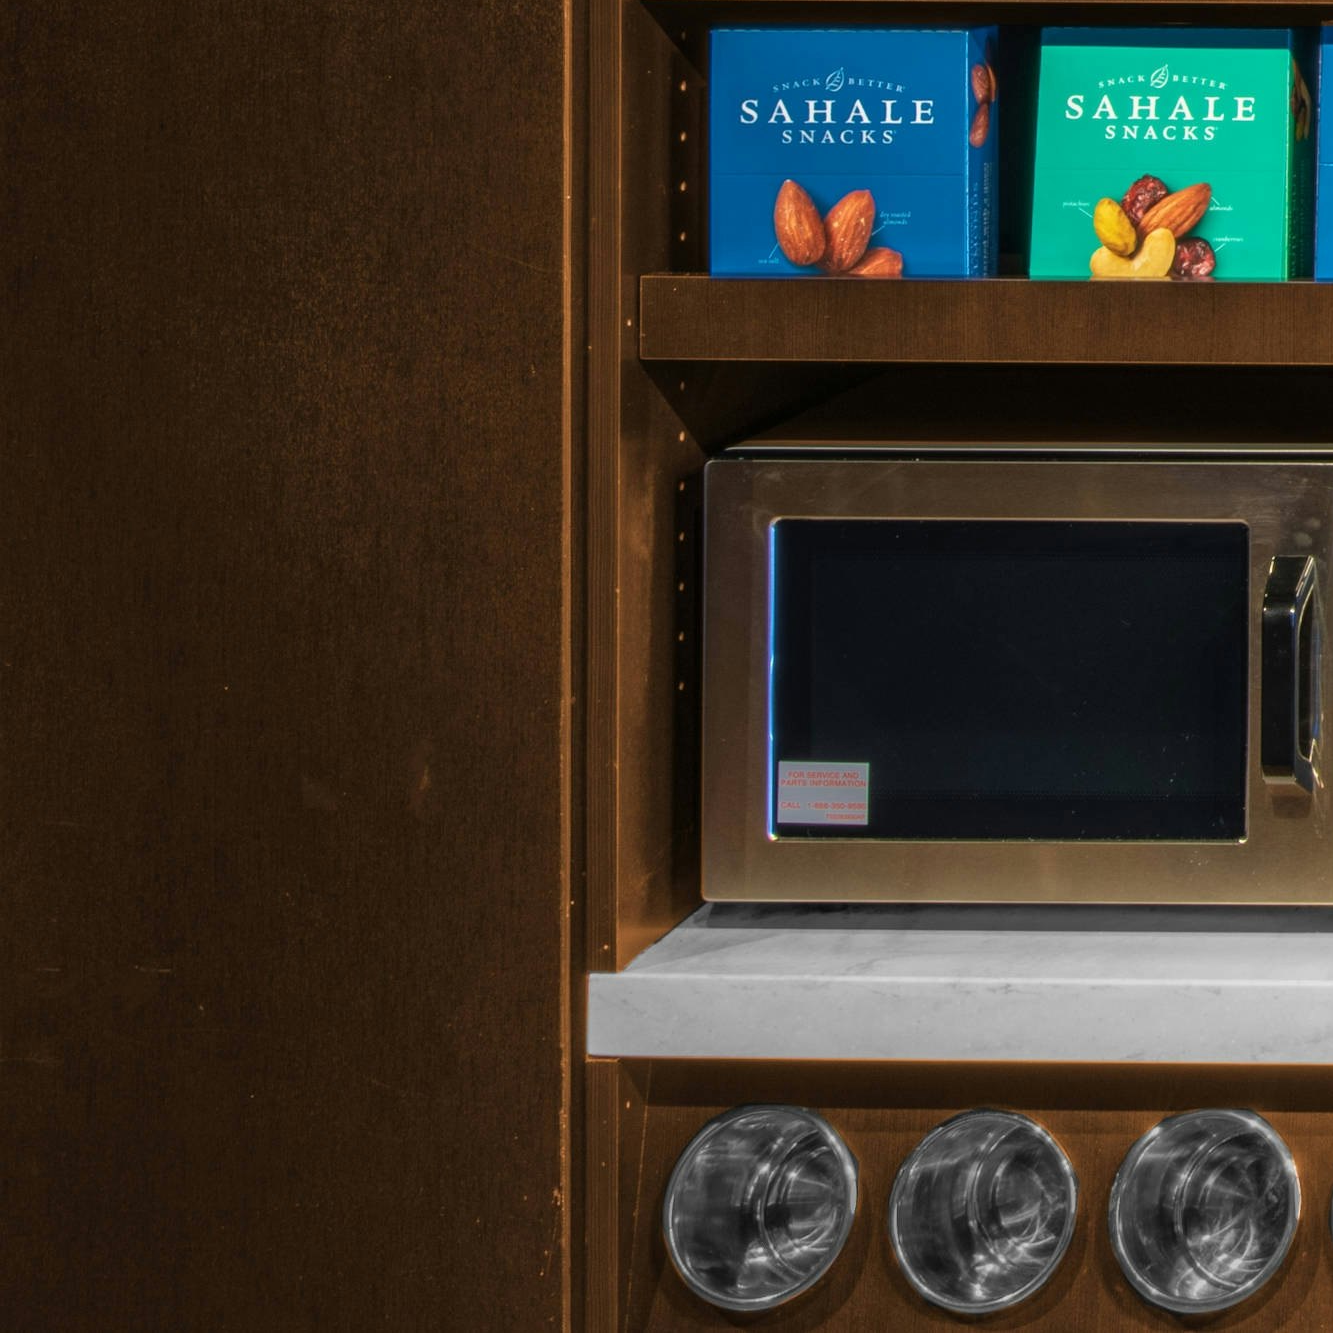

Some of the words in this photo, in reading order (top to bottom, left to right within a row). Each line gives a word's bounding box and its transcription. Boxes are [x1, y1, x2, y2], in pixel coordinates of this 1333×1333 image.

[773, 76, 821, 93] SNACK
[848, 76, 905, 93] BETTER
[1098, 74, 1146, 89] SNACK
[1172, 74, 1227, 90] BETTER
[739, 98, 936, 125] SAHALE
[1064, 94, 1257, 122] SAHALE
[782, 129, 894, 145] SNACKS
[1104, 125, 1216, 141] SNACKS
[806, 771, 840, 779] SERVICE
[809, 779, 867, 787] INFORMATION
